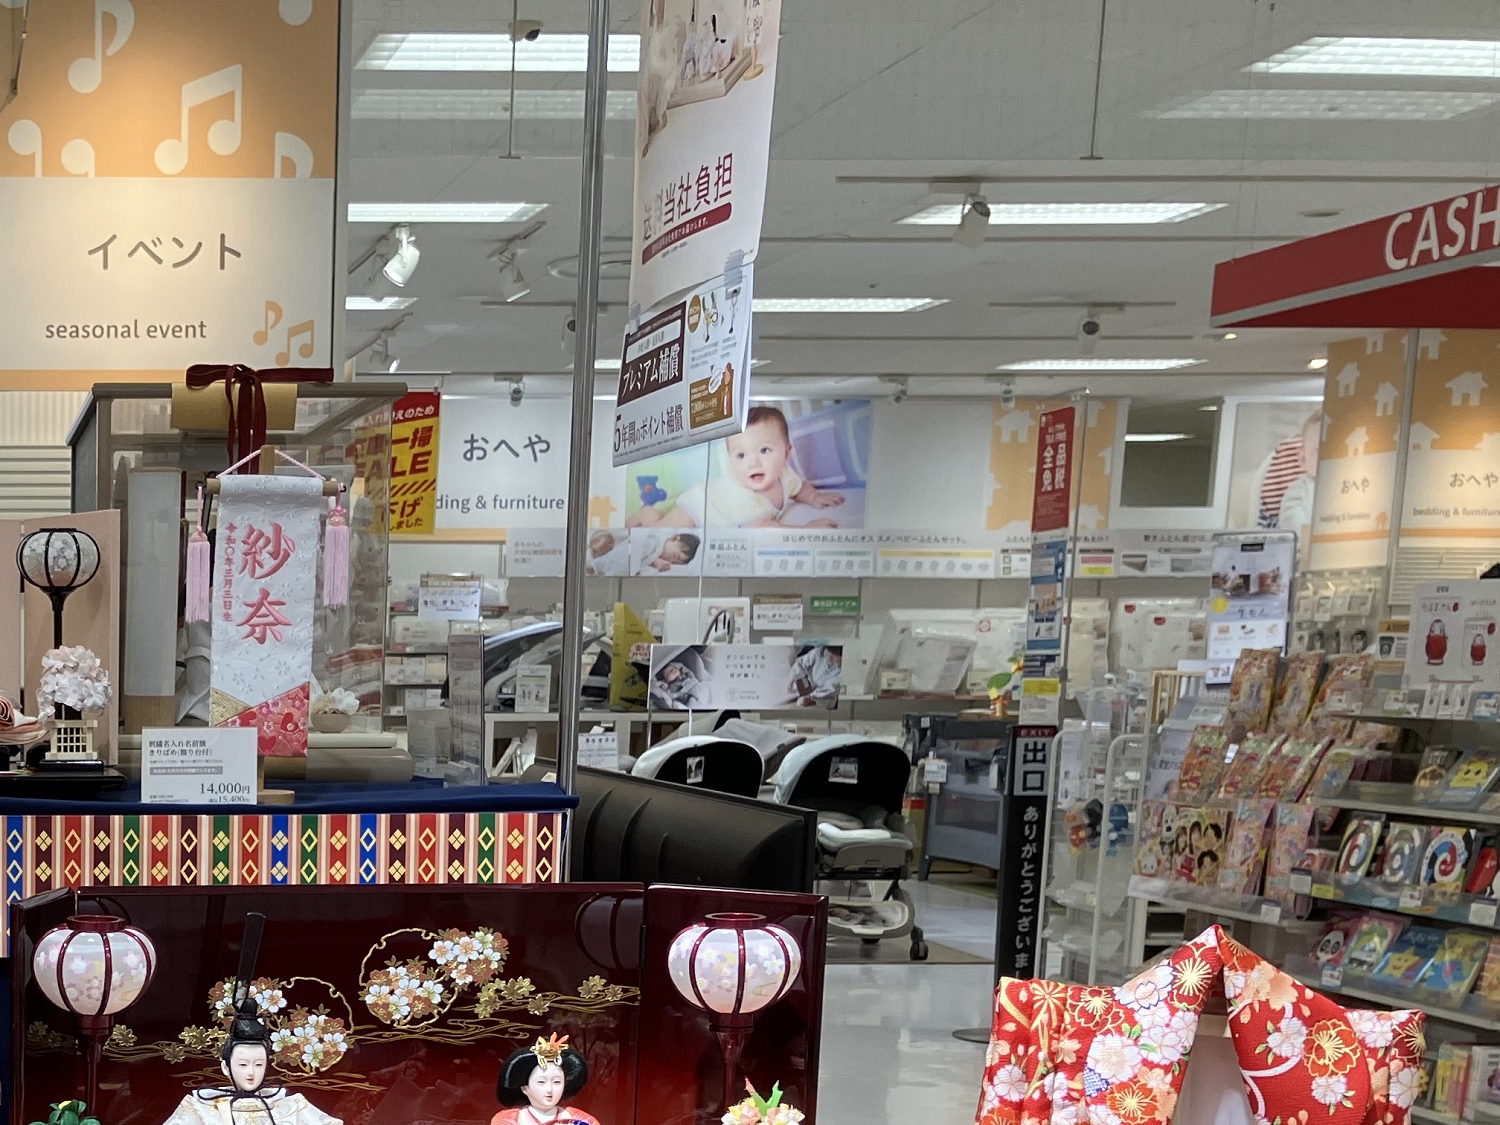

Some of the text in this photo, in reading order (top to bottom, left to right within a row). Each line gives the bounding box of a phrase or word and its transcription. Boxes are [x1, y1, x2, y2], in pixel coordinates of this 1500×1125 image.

[1385, 185, 1500, 271] CASH
[88, 232, 242, 271] イベント
[45, 319, 208, 340] seasonal event
[621, 342, 681, 398] プレミアム補償
[462, 433, 552, 464] おへや
[1449, 471, 1499, 489] おへや
[476, 495, 487, 510] &
[491, 493, 565, 511] furniture
[237, 521, 296, 646] 紗奈
[1020, 728, 1051, 737] EXIT
[1021, 740, 1047, 792] 出口
[199, 782, 251, 795] 14,000円
[1014, 805, 1039, 978] ありがとうございま
